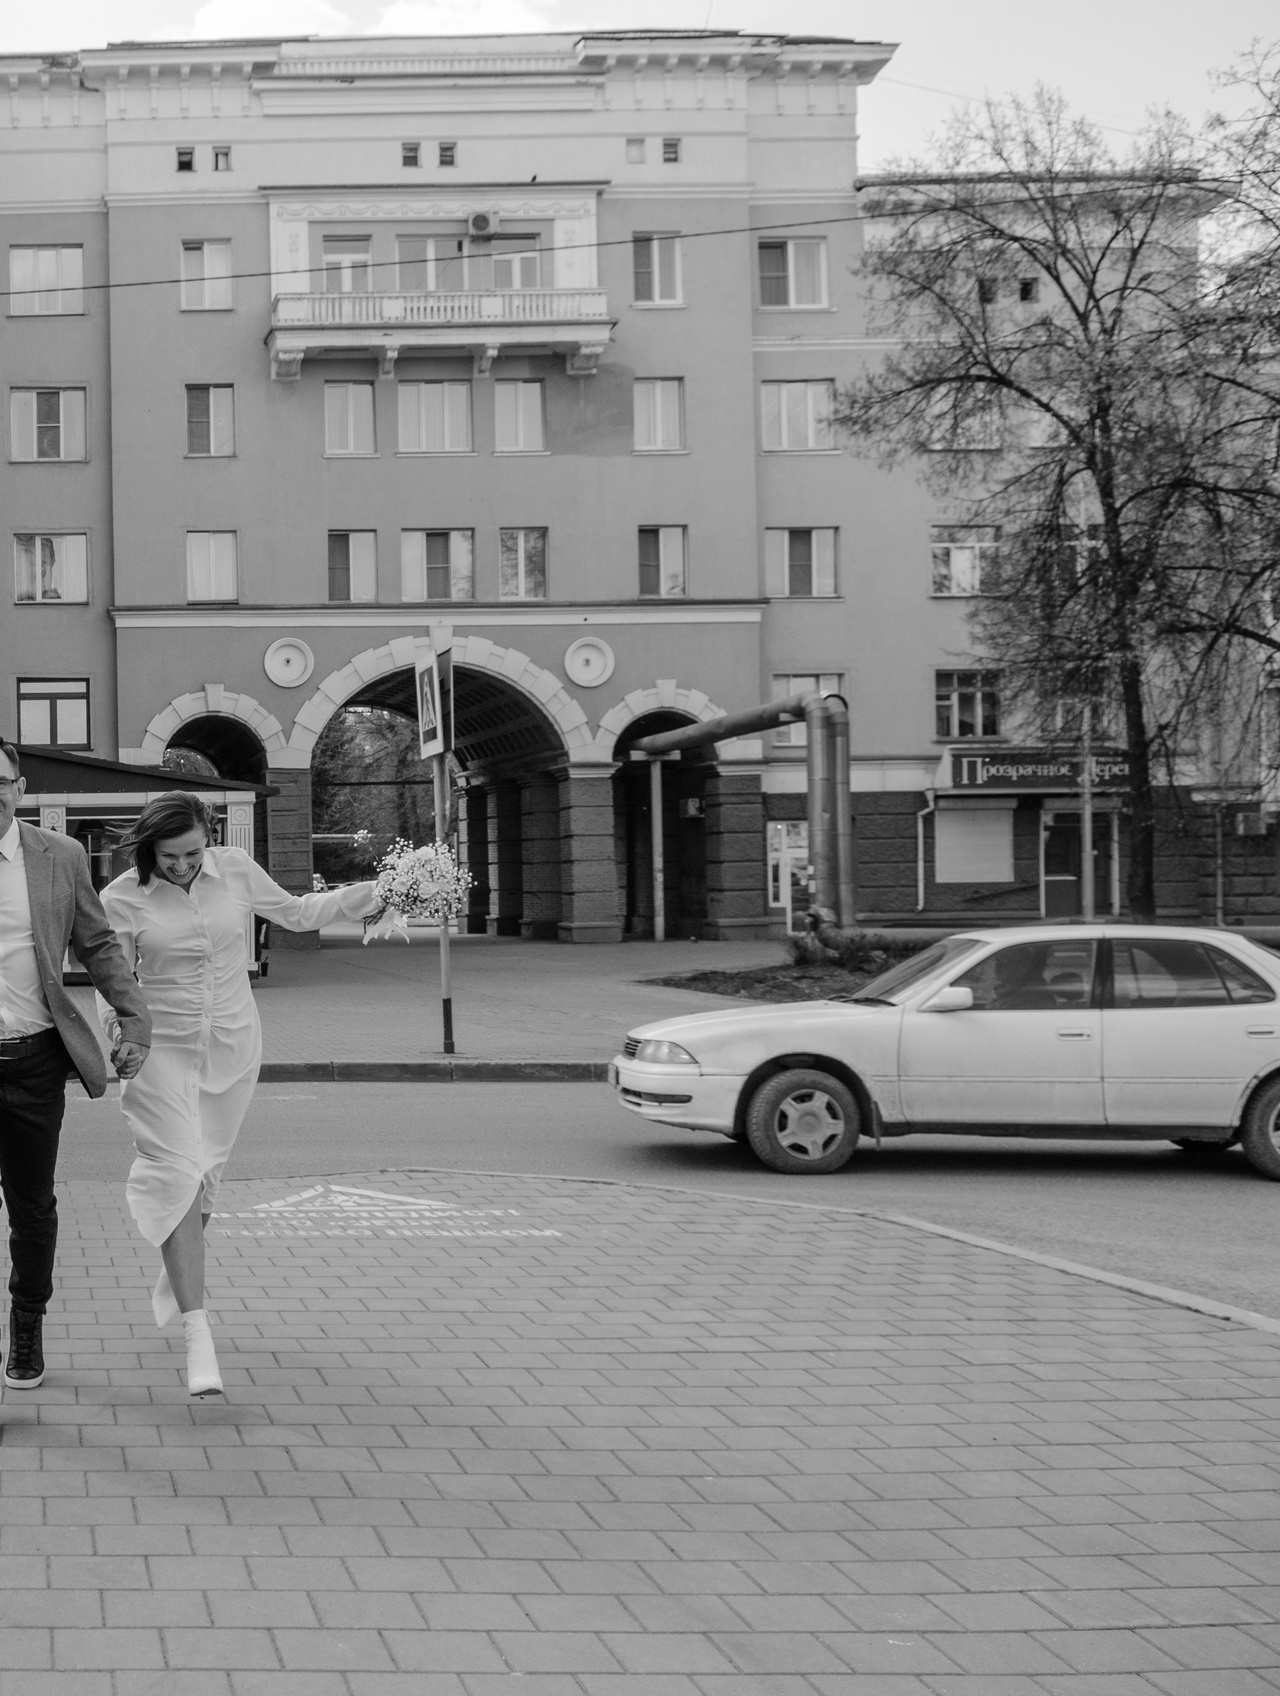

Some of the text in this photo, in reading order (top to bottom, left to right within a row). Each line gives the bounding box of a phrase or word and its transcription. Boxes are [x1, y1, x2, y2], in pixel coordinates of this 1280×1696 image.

[961, 757, 1073, 784] Прозрачное
[261, 1219, 314, 1227] ПО
[213, 1228, 564, 1237] ТОЛЬКО ПЕШКОМ
